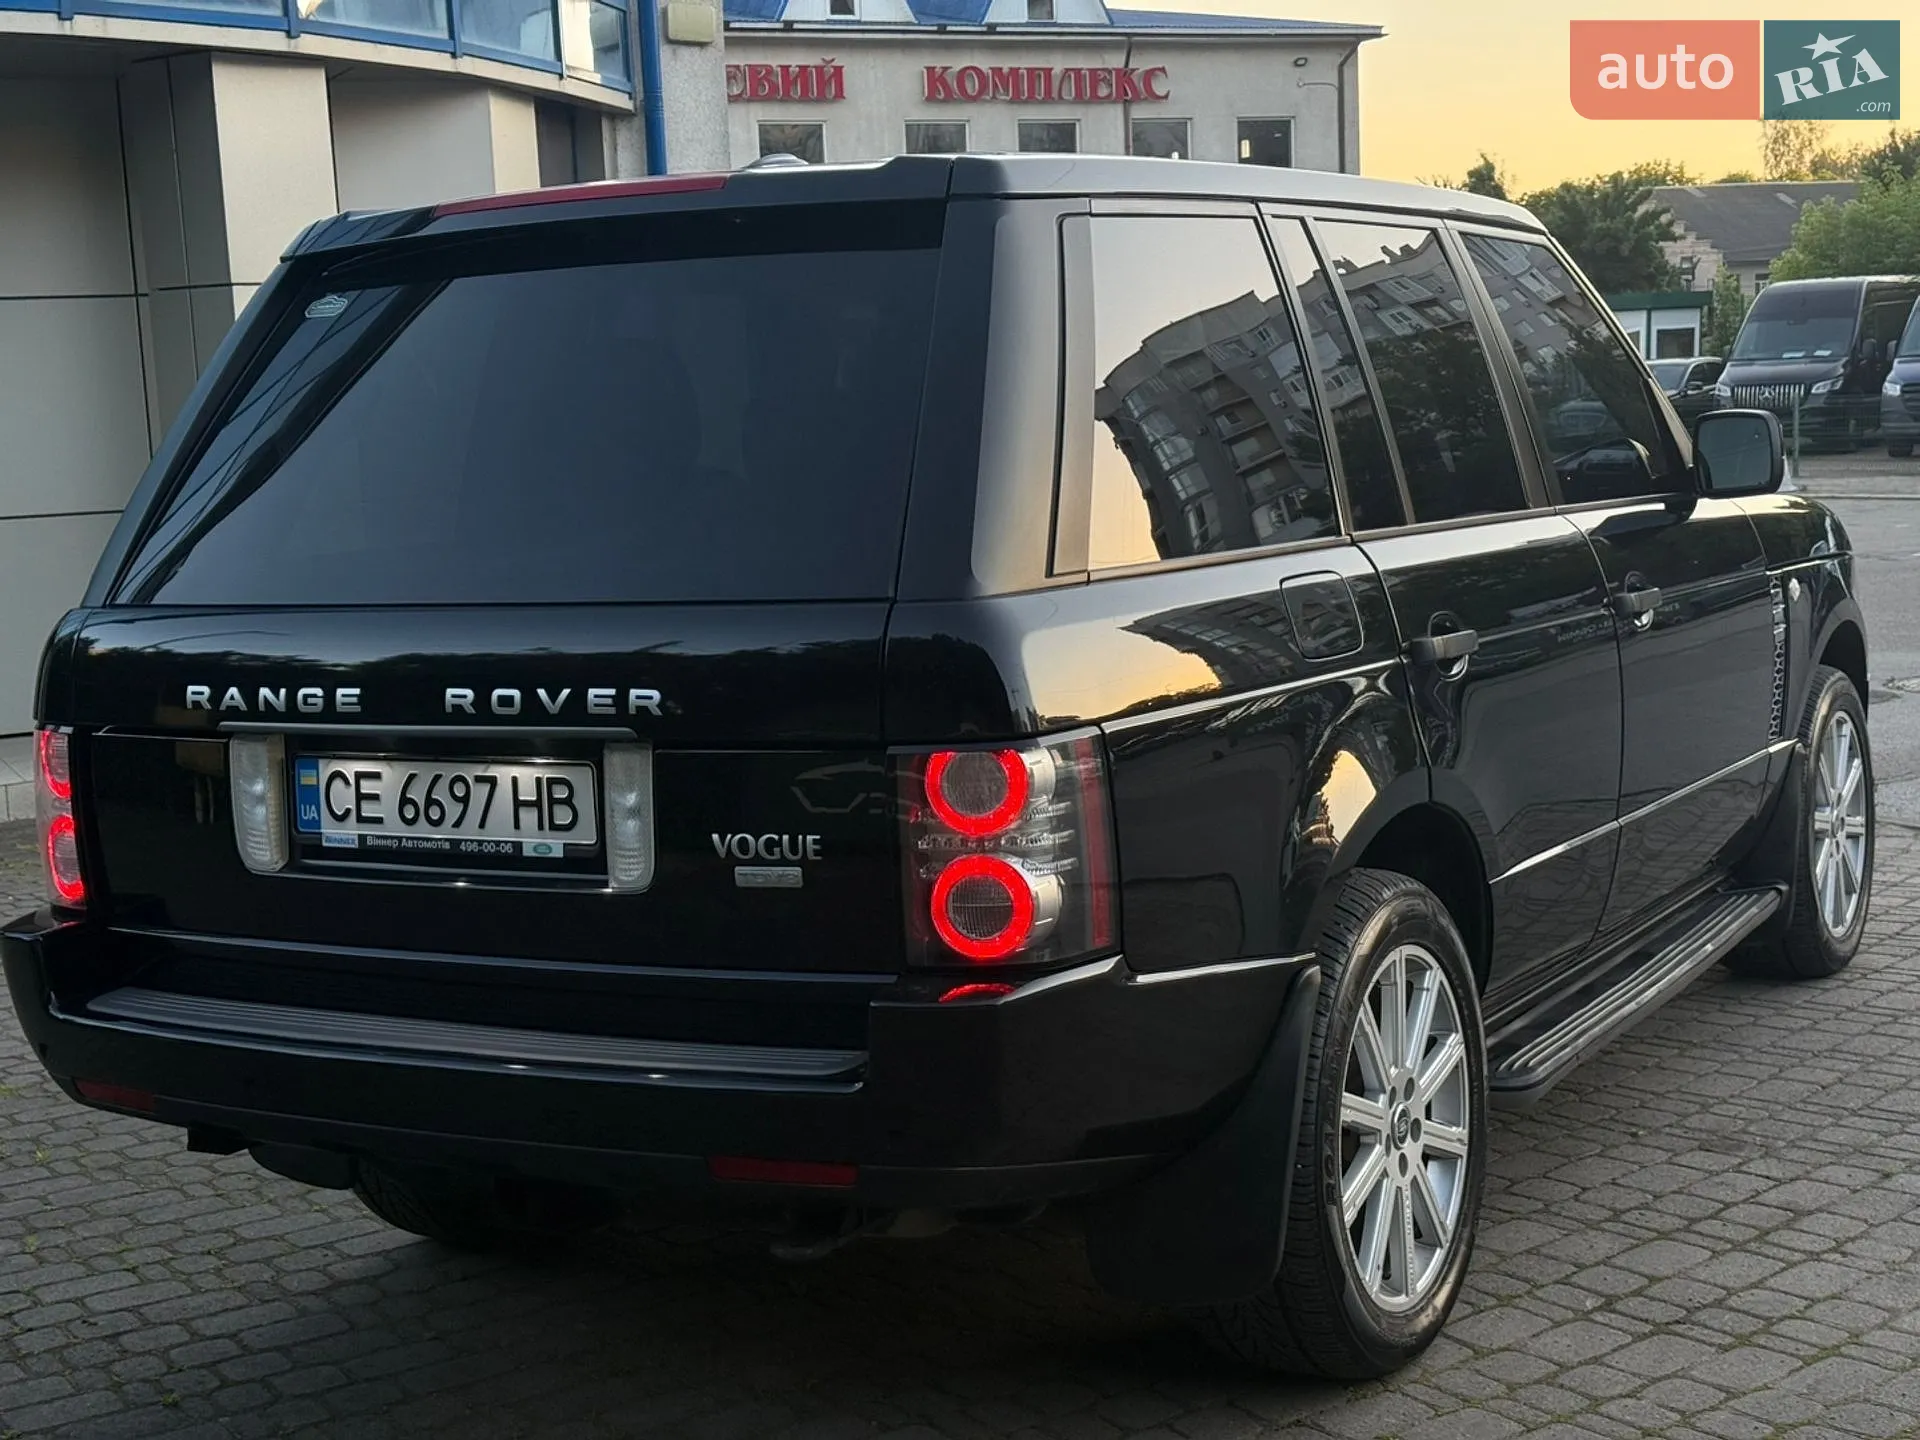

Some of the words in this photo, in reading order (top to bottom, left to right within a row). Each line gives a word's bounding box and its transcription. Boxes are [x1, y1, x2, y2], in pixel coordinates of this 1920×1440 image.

[922, 65, 1171, 101] КОМПЛЕКС
[184, 684, 363, 713] RANGE
[444, 687, 665, 717] ROVER
[300, 803, 319, 821] UA
[323, 768, 385, 825] CE
[397, 771, 499, 830] 6697
[510, 774, 580, 833] HB
[366, 835, 399, 849] Віннер
[459, 841, 514, 854] 496-00-06
[711, 832, 823, 861] VOGUE
